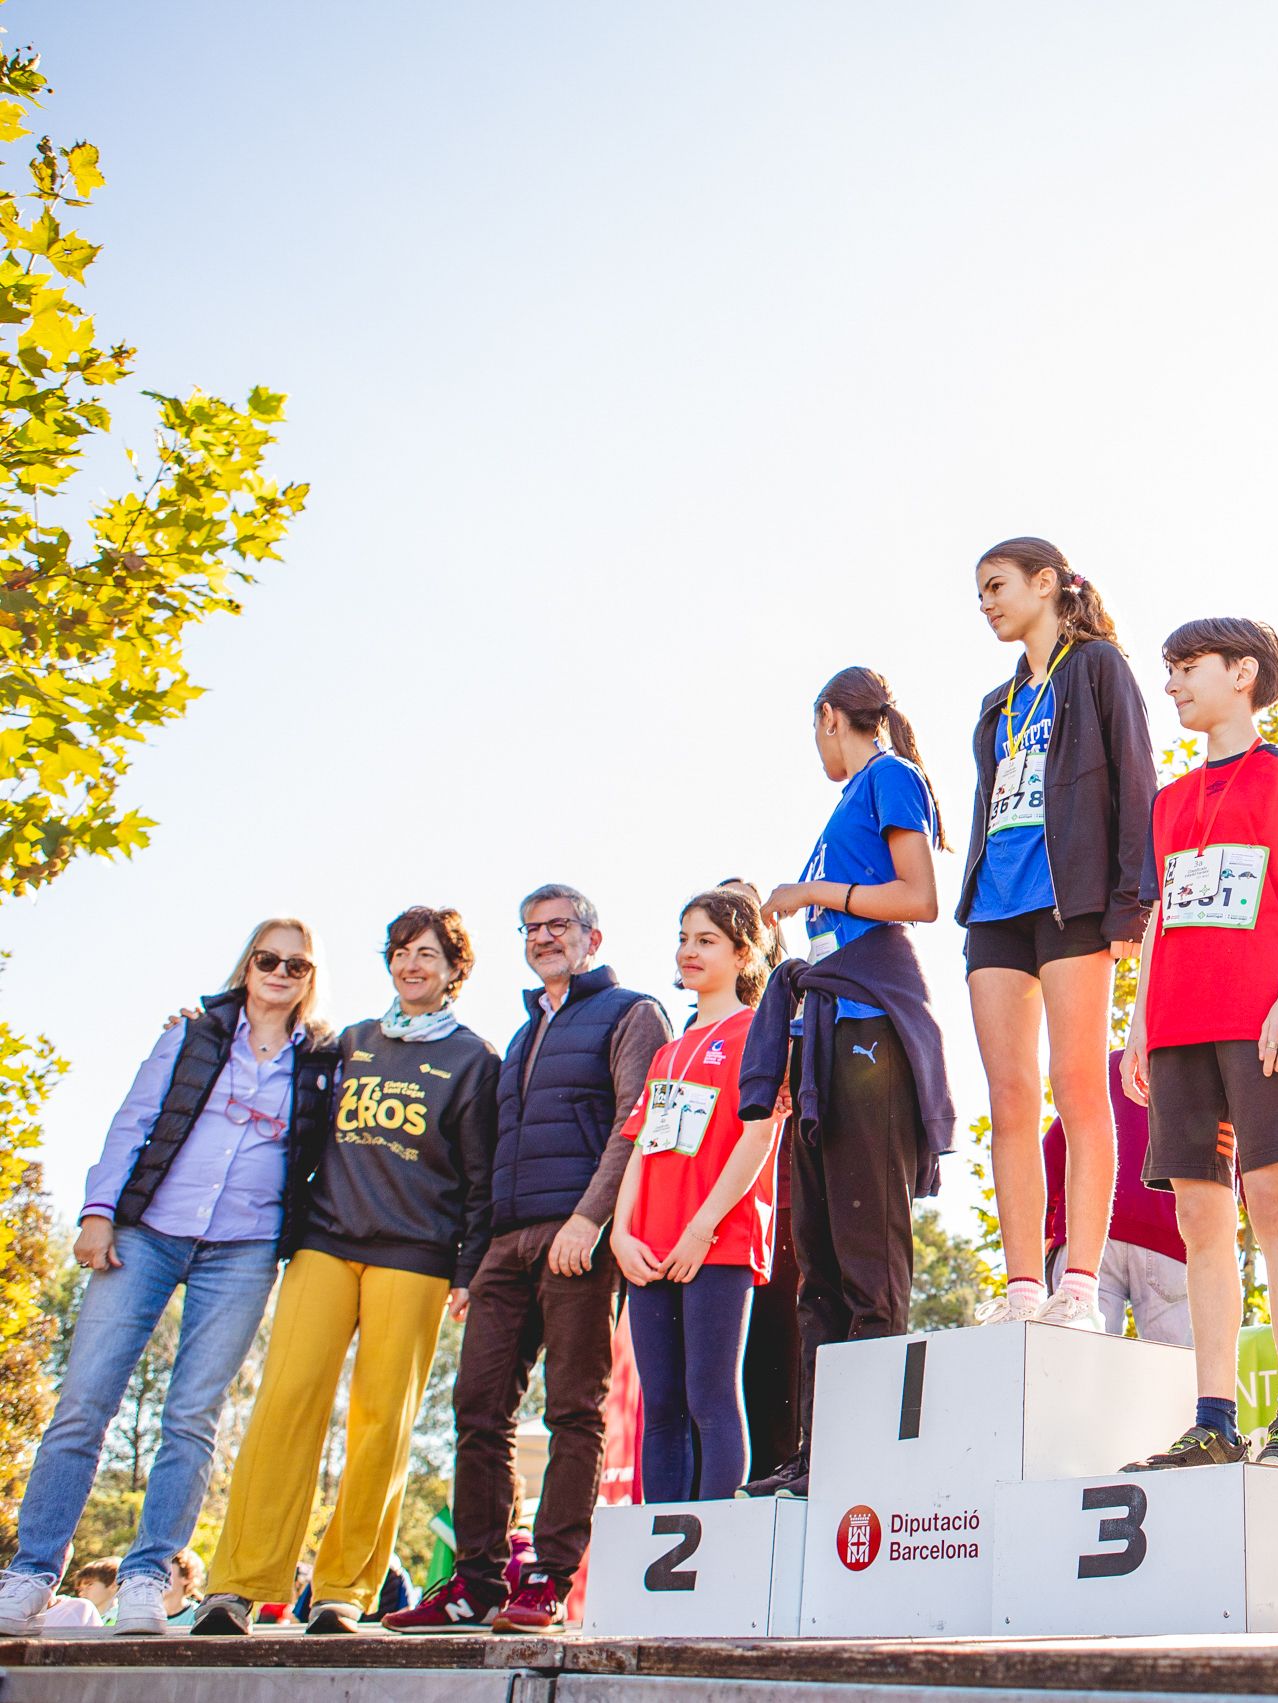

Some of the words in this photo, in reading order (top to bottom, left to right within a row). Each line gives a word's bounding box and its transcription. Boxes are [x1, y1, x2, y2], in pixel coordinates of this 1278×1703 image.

[336, 1098, 428, 1136] CROS
[890, 1509, 980, 1538] Diputació
[1077, 1483, 1149, 1579] 3
[643, 1513, 703, 1592] 2
[889, 1539, 980, 1561] Barcelona
